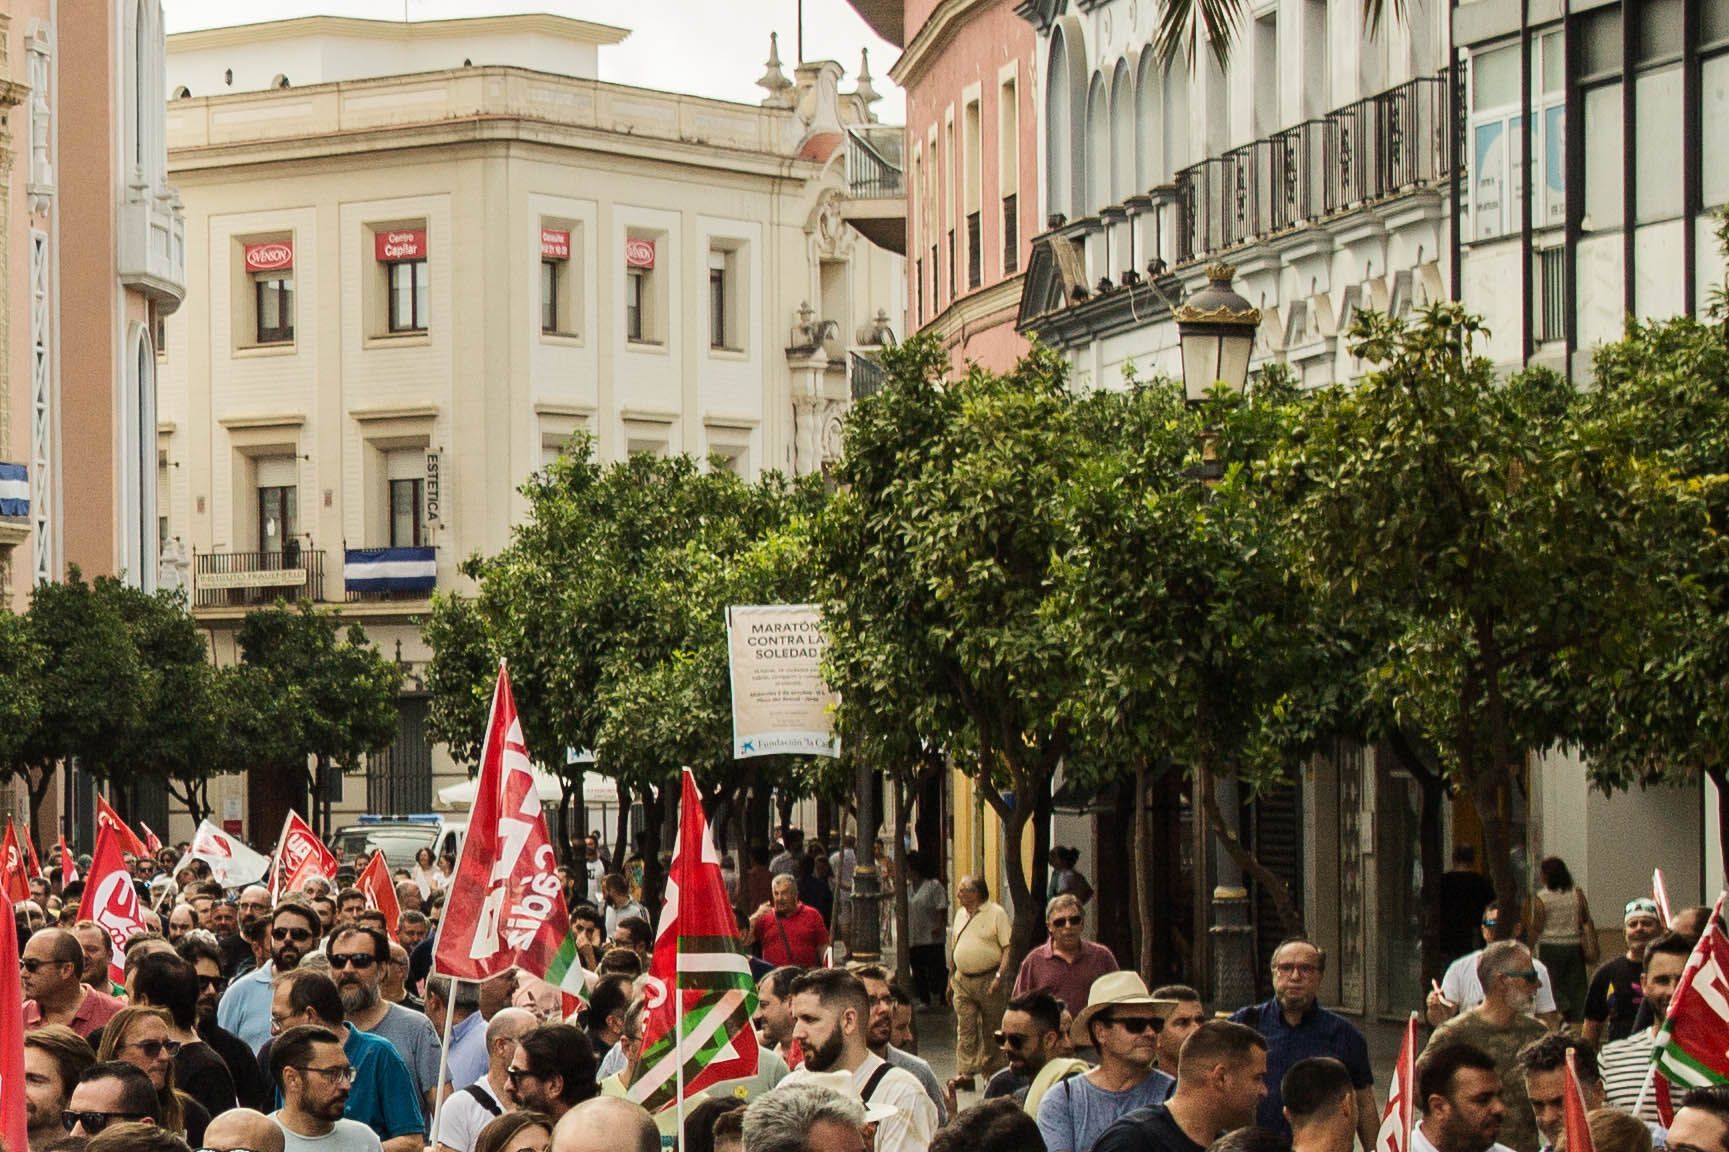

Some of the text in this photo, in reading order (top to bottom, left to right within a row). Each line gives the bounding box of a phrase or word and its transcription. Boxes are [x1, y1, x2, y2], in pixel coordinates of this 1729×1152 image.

[385, 245, 417, 258] Capilar
[427, 454, 440, 522] ESTETICA
[752, 621, 819, 634] MARATÓN
[747, 635, 825, 647] CONTRA LA
[756, 648, 818, 660] SOLEDAD
